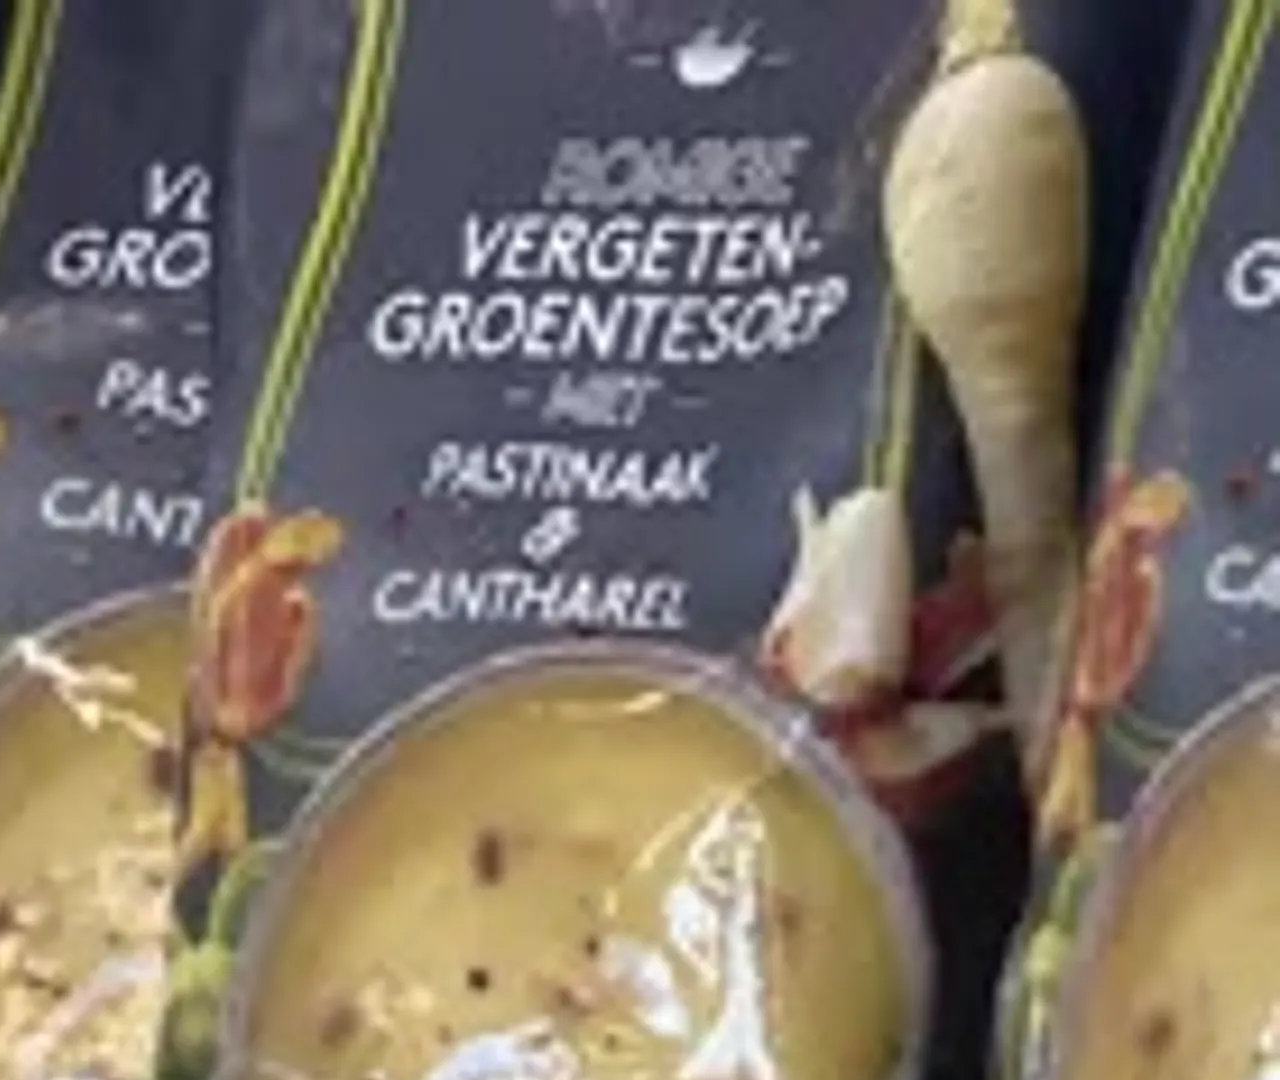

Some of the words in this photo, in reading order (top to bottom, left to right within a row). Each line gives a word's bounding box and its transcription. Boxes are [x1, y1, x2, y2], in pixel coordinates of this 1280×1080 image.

[49, 227, 212, 290] GRO
[462, 212, 824, 284] VERGETEN-
[368, 275, 850, 363] GROENTESOEP
[96, 358, 211, 426] PAS
[422, 440, 722, 504] PASTINAAK
[374, 568, 692, 632] CANTHAREL
